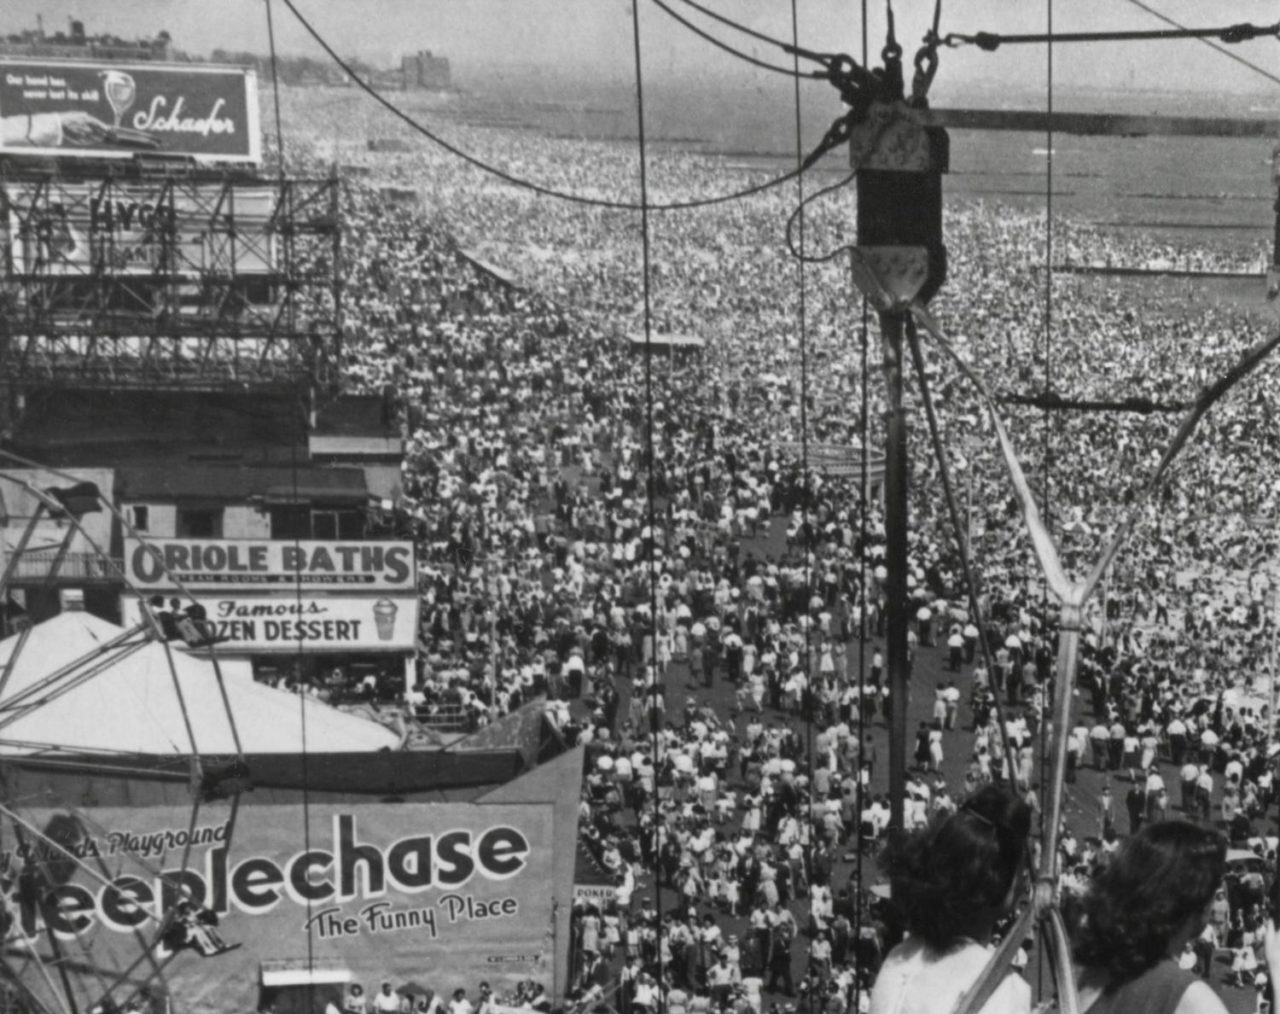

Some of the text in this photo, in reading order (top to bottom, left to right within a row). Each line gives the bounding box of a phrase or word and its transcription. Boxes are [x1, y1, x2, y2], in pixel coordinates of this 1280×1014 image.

[133, 95, 235, 136] Schaefer
[132, 543, 410, 584] ORIOLE BATHS
[221, 574, 267, 583] ROOMS
[217, 600, 328, 618] Famous
[206, 619, 362, 641] OZEN DESSERT
[107, 819, 231, 858] Playground
[305, 894, 518, 938] The Funny Place
